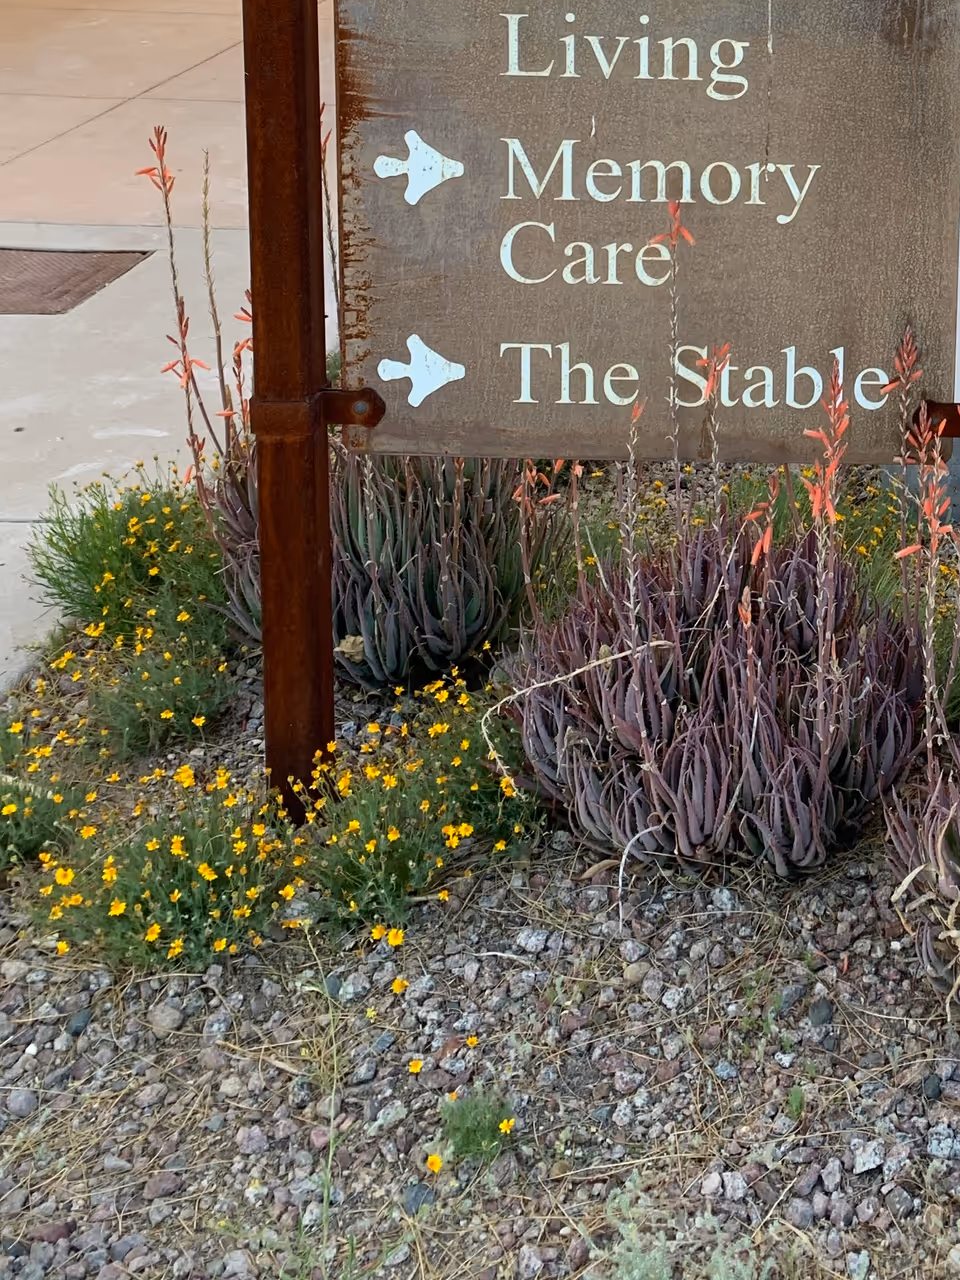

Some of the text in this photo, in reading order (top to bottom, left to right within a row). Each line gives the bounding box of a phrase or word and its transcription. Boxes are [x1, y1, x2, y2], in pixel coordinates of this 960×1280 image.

[499, 12, 750, 101] Living
[499, 137, 822, 225] Memory
[499, 221, 673, 287] Care
[499, 342, 890, 411] The Stable
